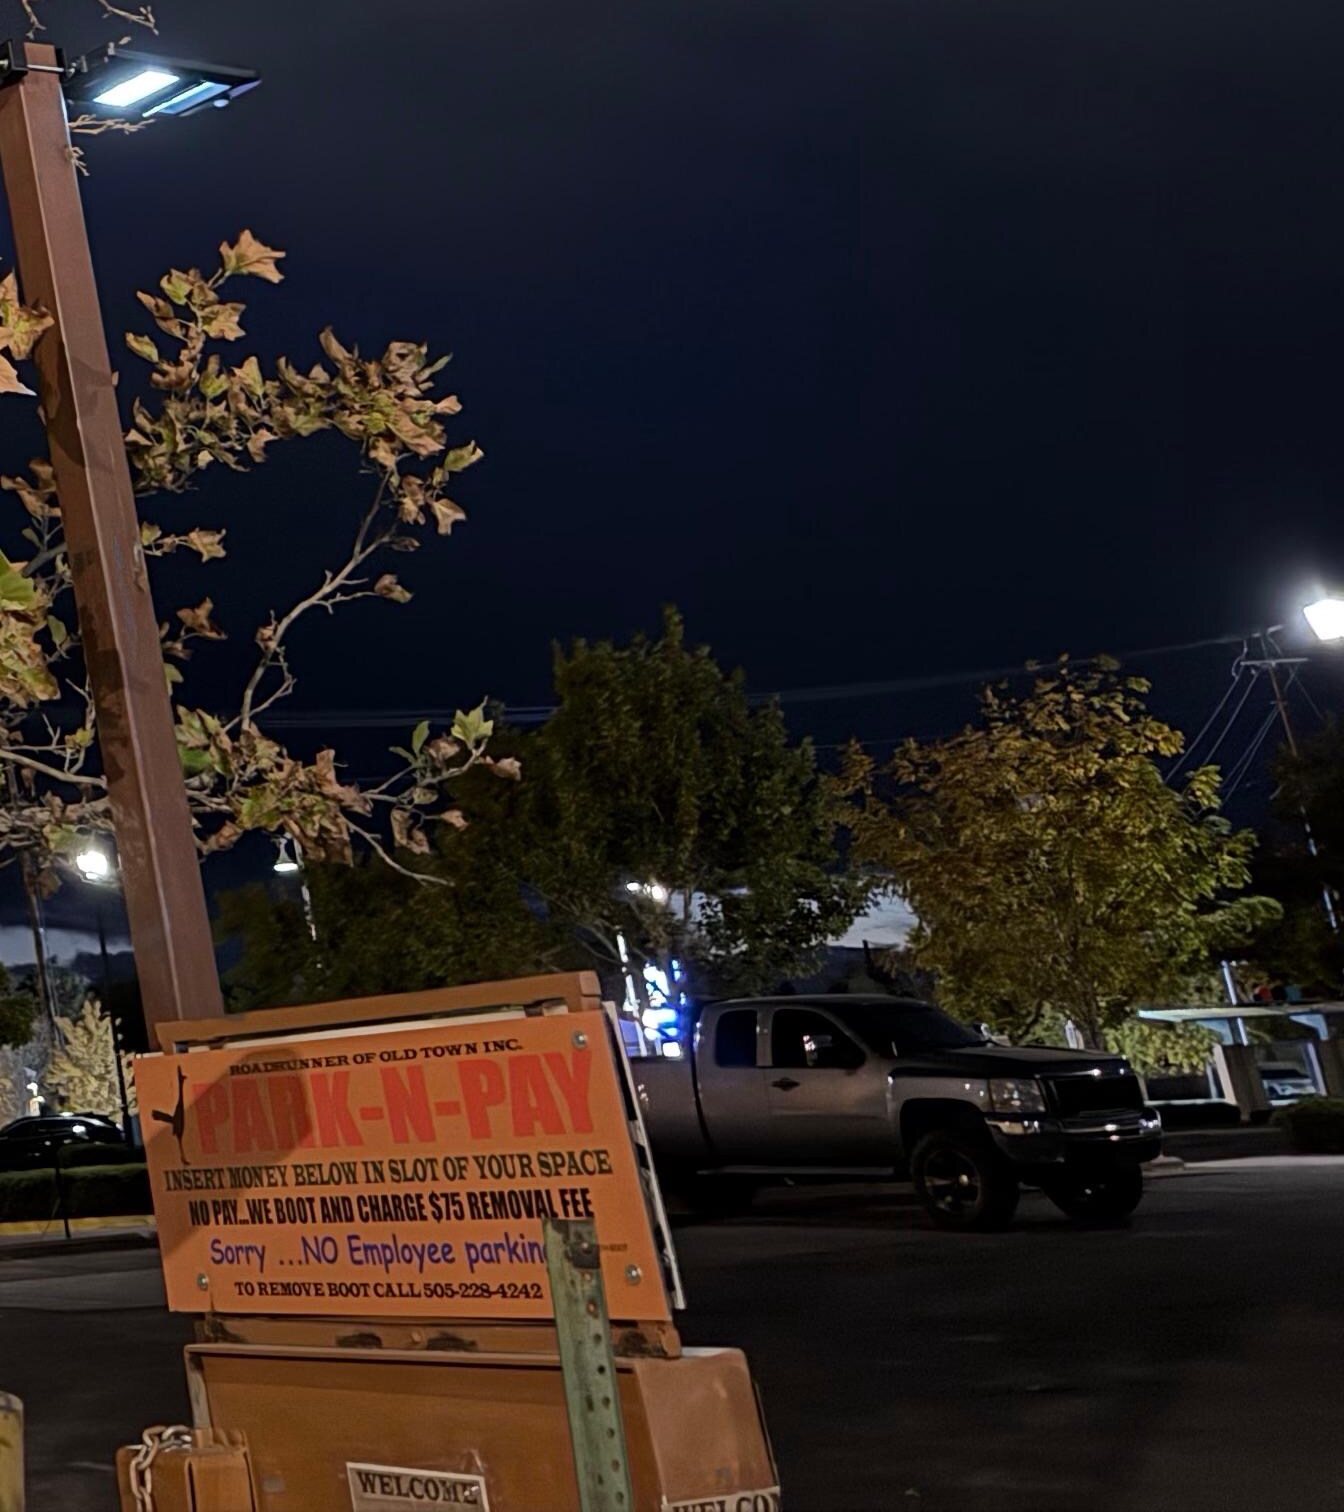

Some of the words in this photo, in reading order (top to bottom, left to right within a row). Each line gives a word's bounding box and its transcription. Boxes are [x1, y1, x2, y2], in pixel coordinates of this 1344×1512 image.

[229, 1054, 350, 1076] ROADRUNNER
[352, 1052, 378, 1065] OF
[379, 1047, 418, 1063] OLD
[420, 1041, 479, 1059] TOWN
[483, 1038, 524, 1053] INC.
[192, 1051, 593, 1154] PARK-N-PAY
[165, 1169, 225, 1191] INSERT
[226, 1164, 289, 1190] MONEY
[291, 1160, 359, 1186] BELOW
[361, 1159, 386, 1184] IN
[388, 1157, 440, 1184] SLOT
[442, 1155, 470, 1183] OF
[472, 1152, 536, 1180] YOUR
[537, 1149, 612, 1177] SPACE
[189, 1200, 211, 1226] NO
[274, 1196, 318, 1224] BOOT
[319, 1194, 355, 1223] AND
[356, 1191, 429, 1223] CHARGE
[428, 1190, 466, 1224] $75
[466, 1189, 559, 1220] REMOVAL
[558, 1188, 596, 1219] FEE
[210, 1238, 266, 1273] Sorry
[347, 1232, 456, 1274] Employee
[464, 1232, 548, 1274] parkin
[234, 1282, 256, 1296] TO
[256, 1281, 326, 1297] REMOVE
[328, 1282, 372, 1298] BOOT
[372, 1282, 422, 1298] CALL
[423, 1282, 544, 1299] 505-228-4242
[357, 1471, 478, 1504] WELCOME
